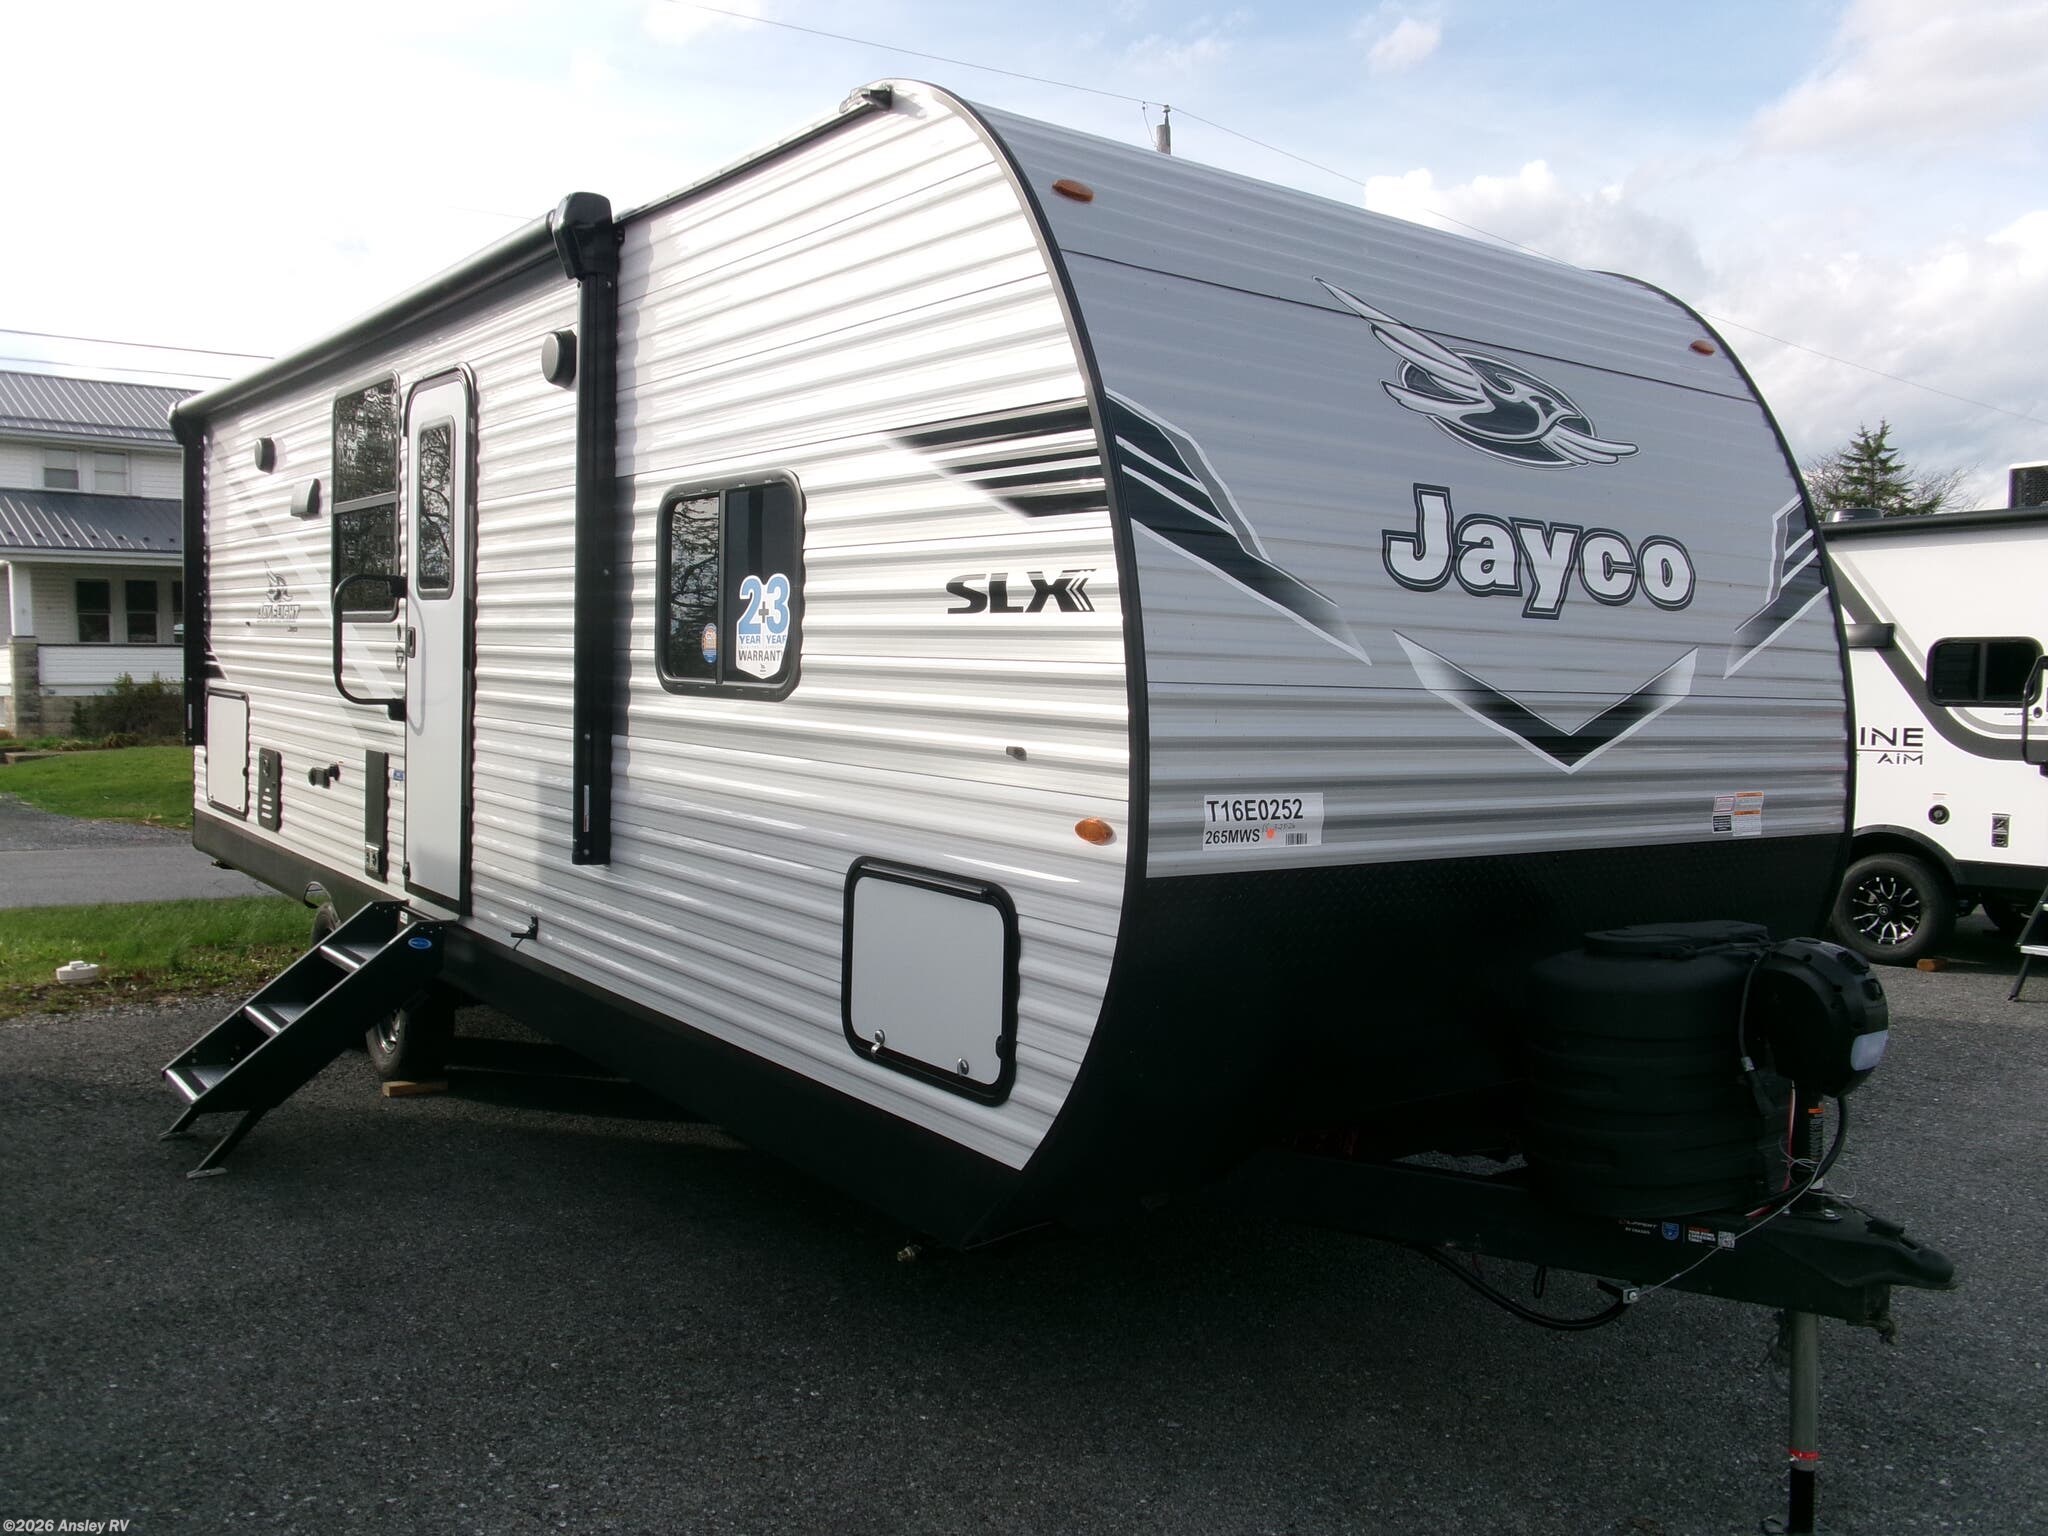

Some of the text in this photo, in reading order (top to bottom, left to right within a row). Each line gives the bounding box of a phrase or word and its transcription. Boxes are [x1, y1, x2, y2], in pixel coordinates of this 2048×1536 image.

[1381, 482, 1697, 621] Jayco
[946, 568, 1097, 615] SLX
[739, 635, 761, 645] YEAR
[738, 649, 784, 662] WARRANT
[1860, 727, 1924, 747] INE
[1206, 798, 1304, 822] T16E0252
[1205, 828, 1260, 845] 265MWS
